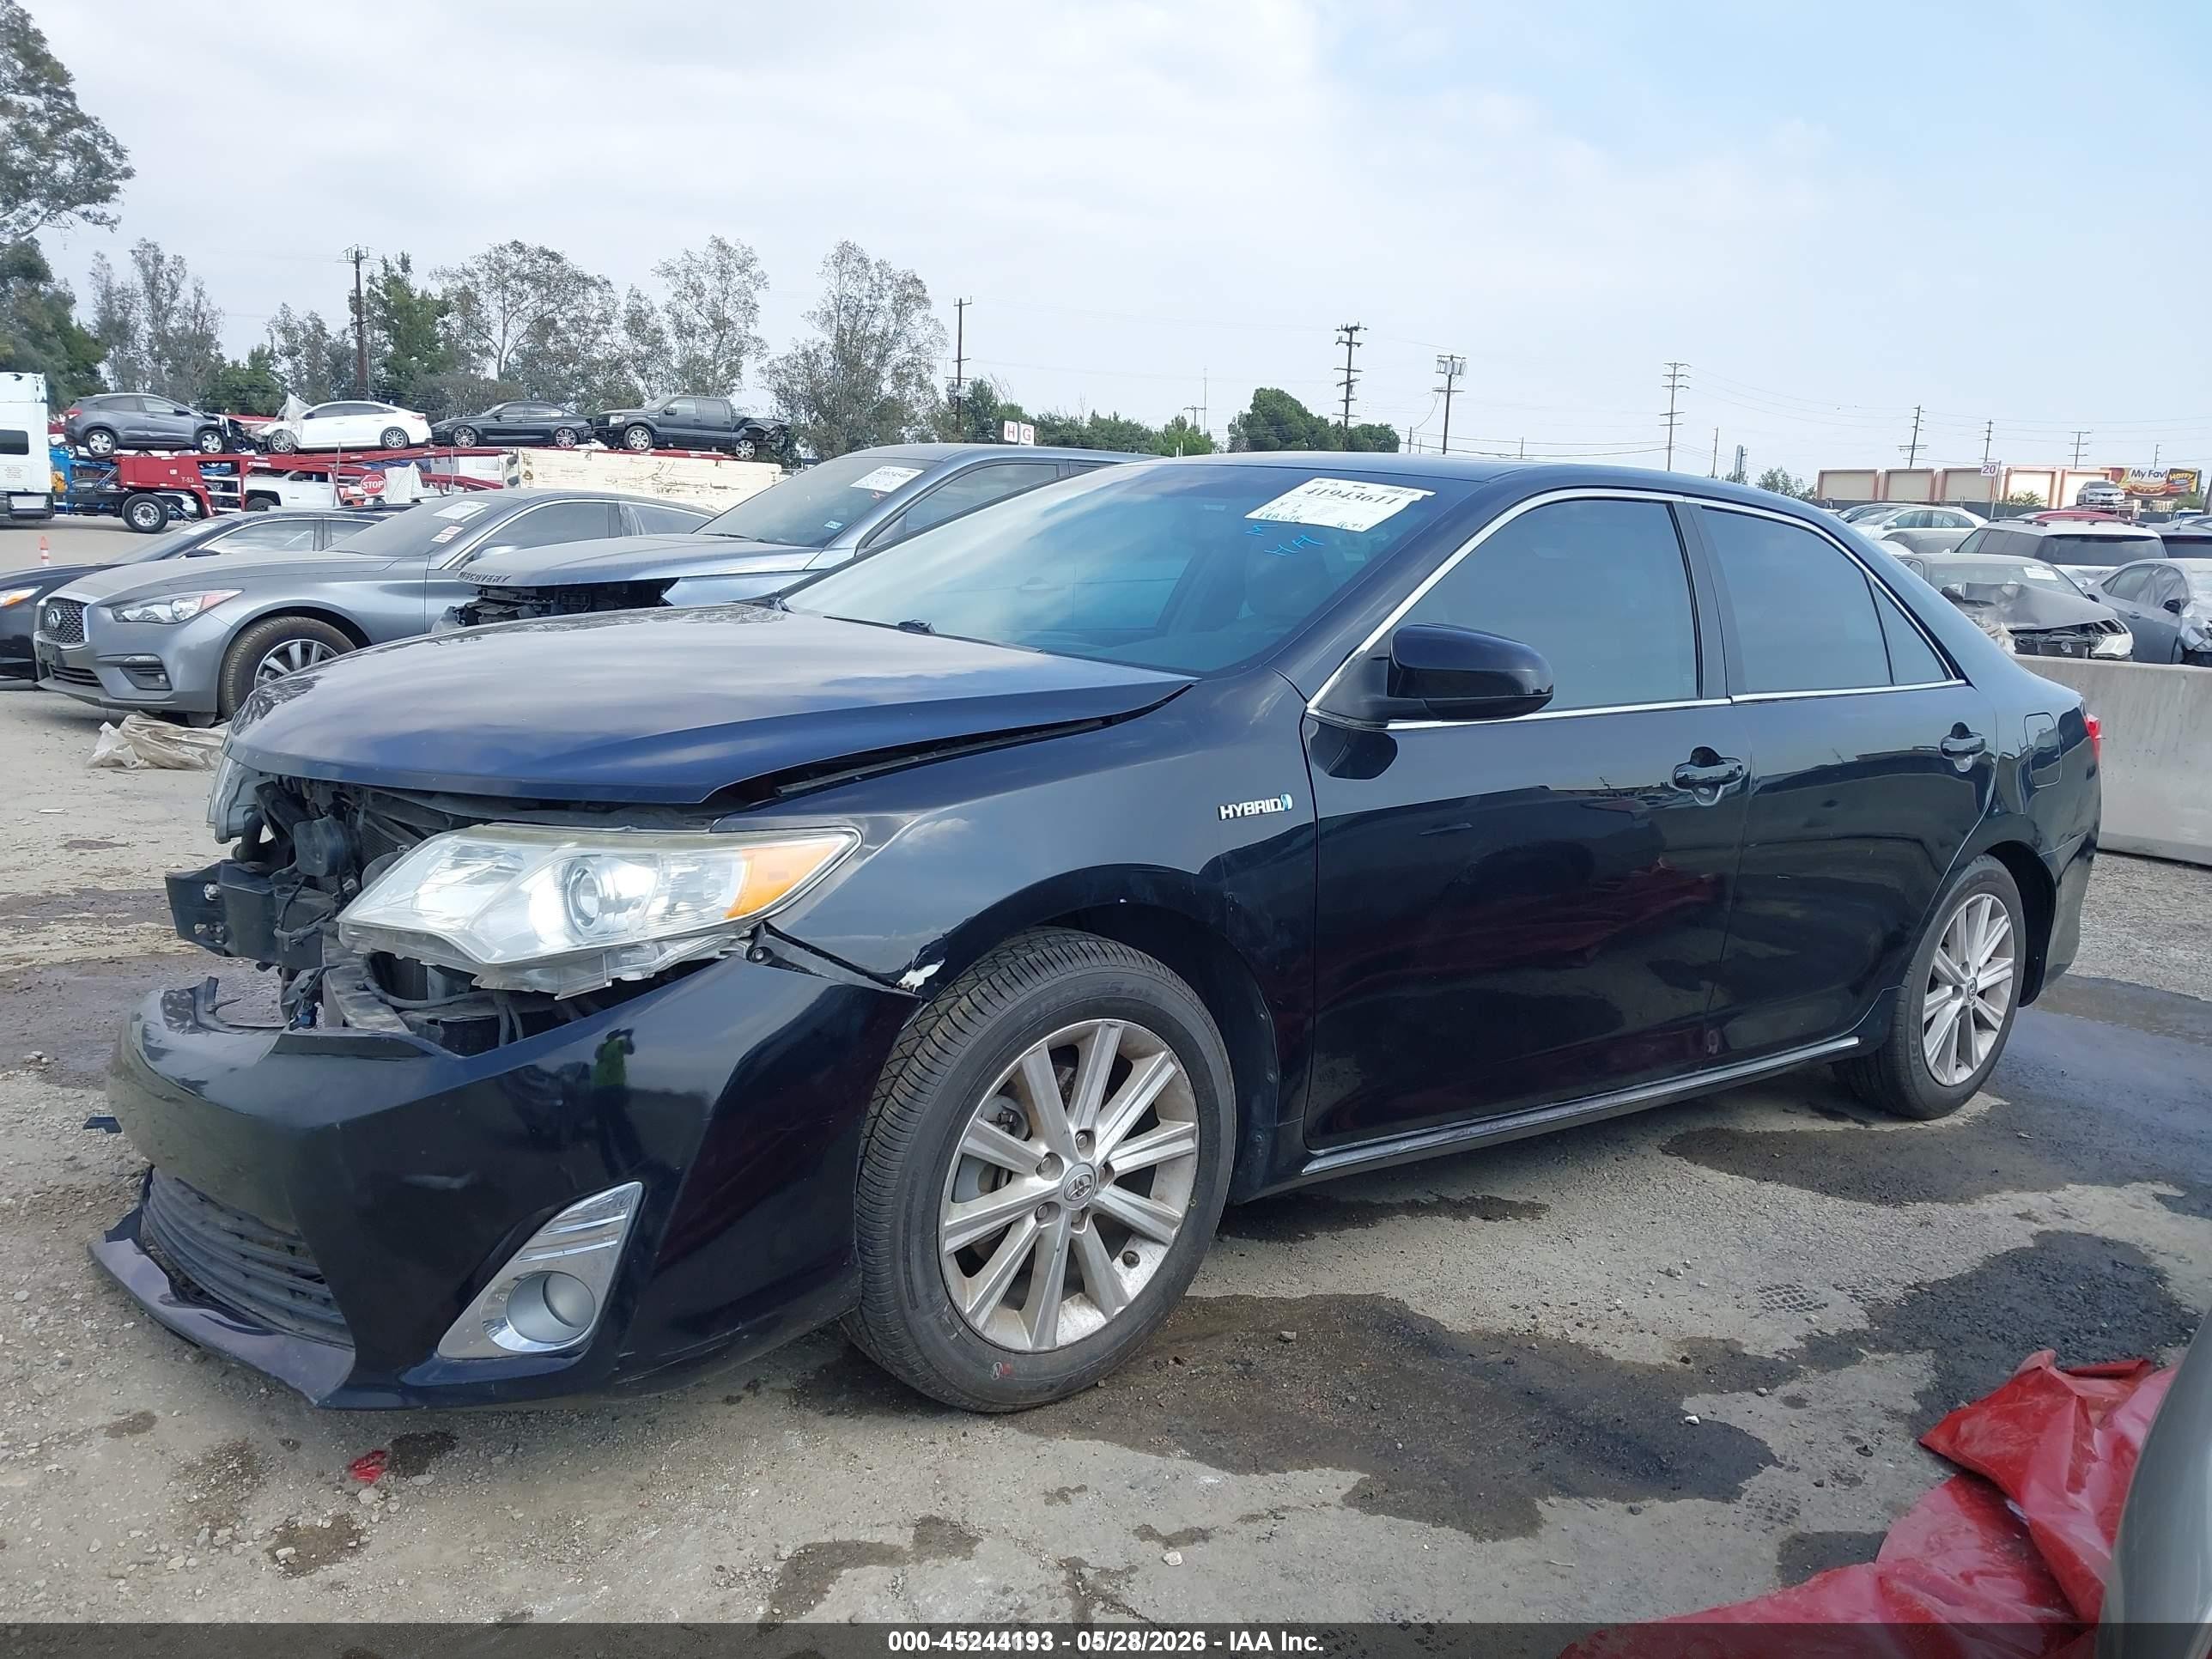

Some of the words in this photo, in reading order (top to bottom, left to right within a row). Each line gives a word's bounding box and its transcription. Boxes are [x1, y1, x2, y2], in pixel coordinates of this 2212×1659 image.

[1007, 424, 1015, 439] H
[1023, 428, 1031, 441] G
[1982, 465, 1996, 474] 20
[2130, 470, 2147, 480] My
[2148, 469, 2168, 479] Fav!
[362, 480, 384, 489] STOP
[1303, 487, 1401, 505] 41943611
[1219, 798, 1284, 820] HYBRID
